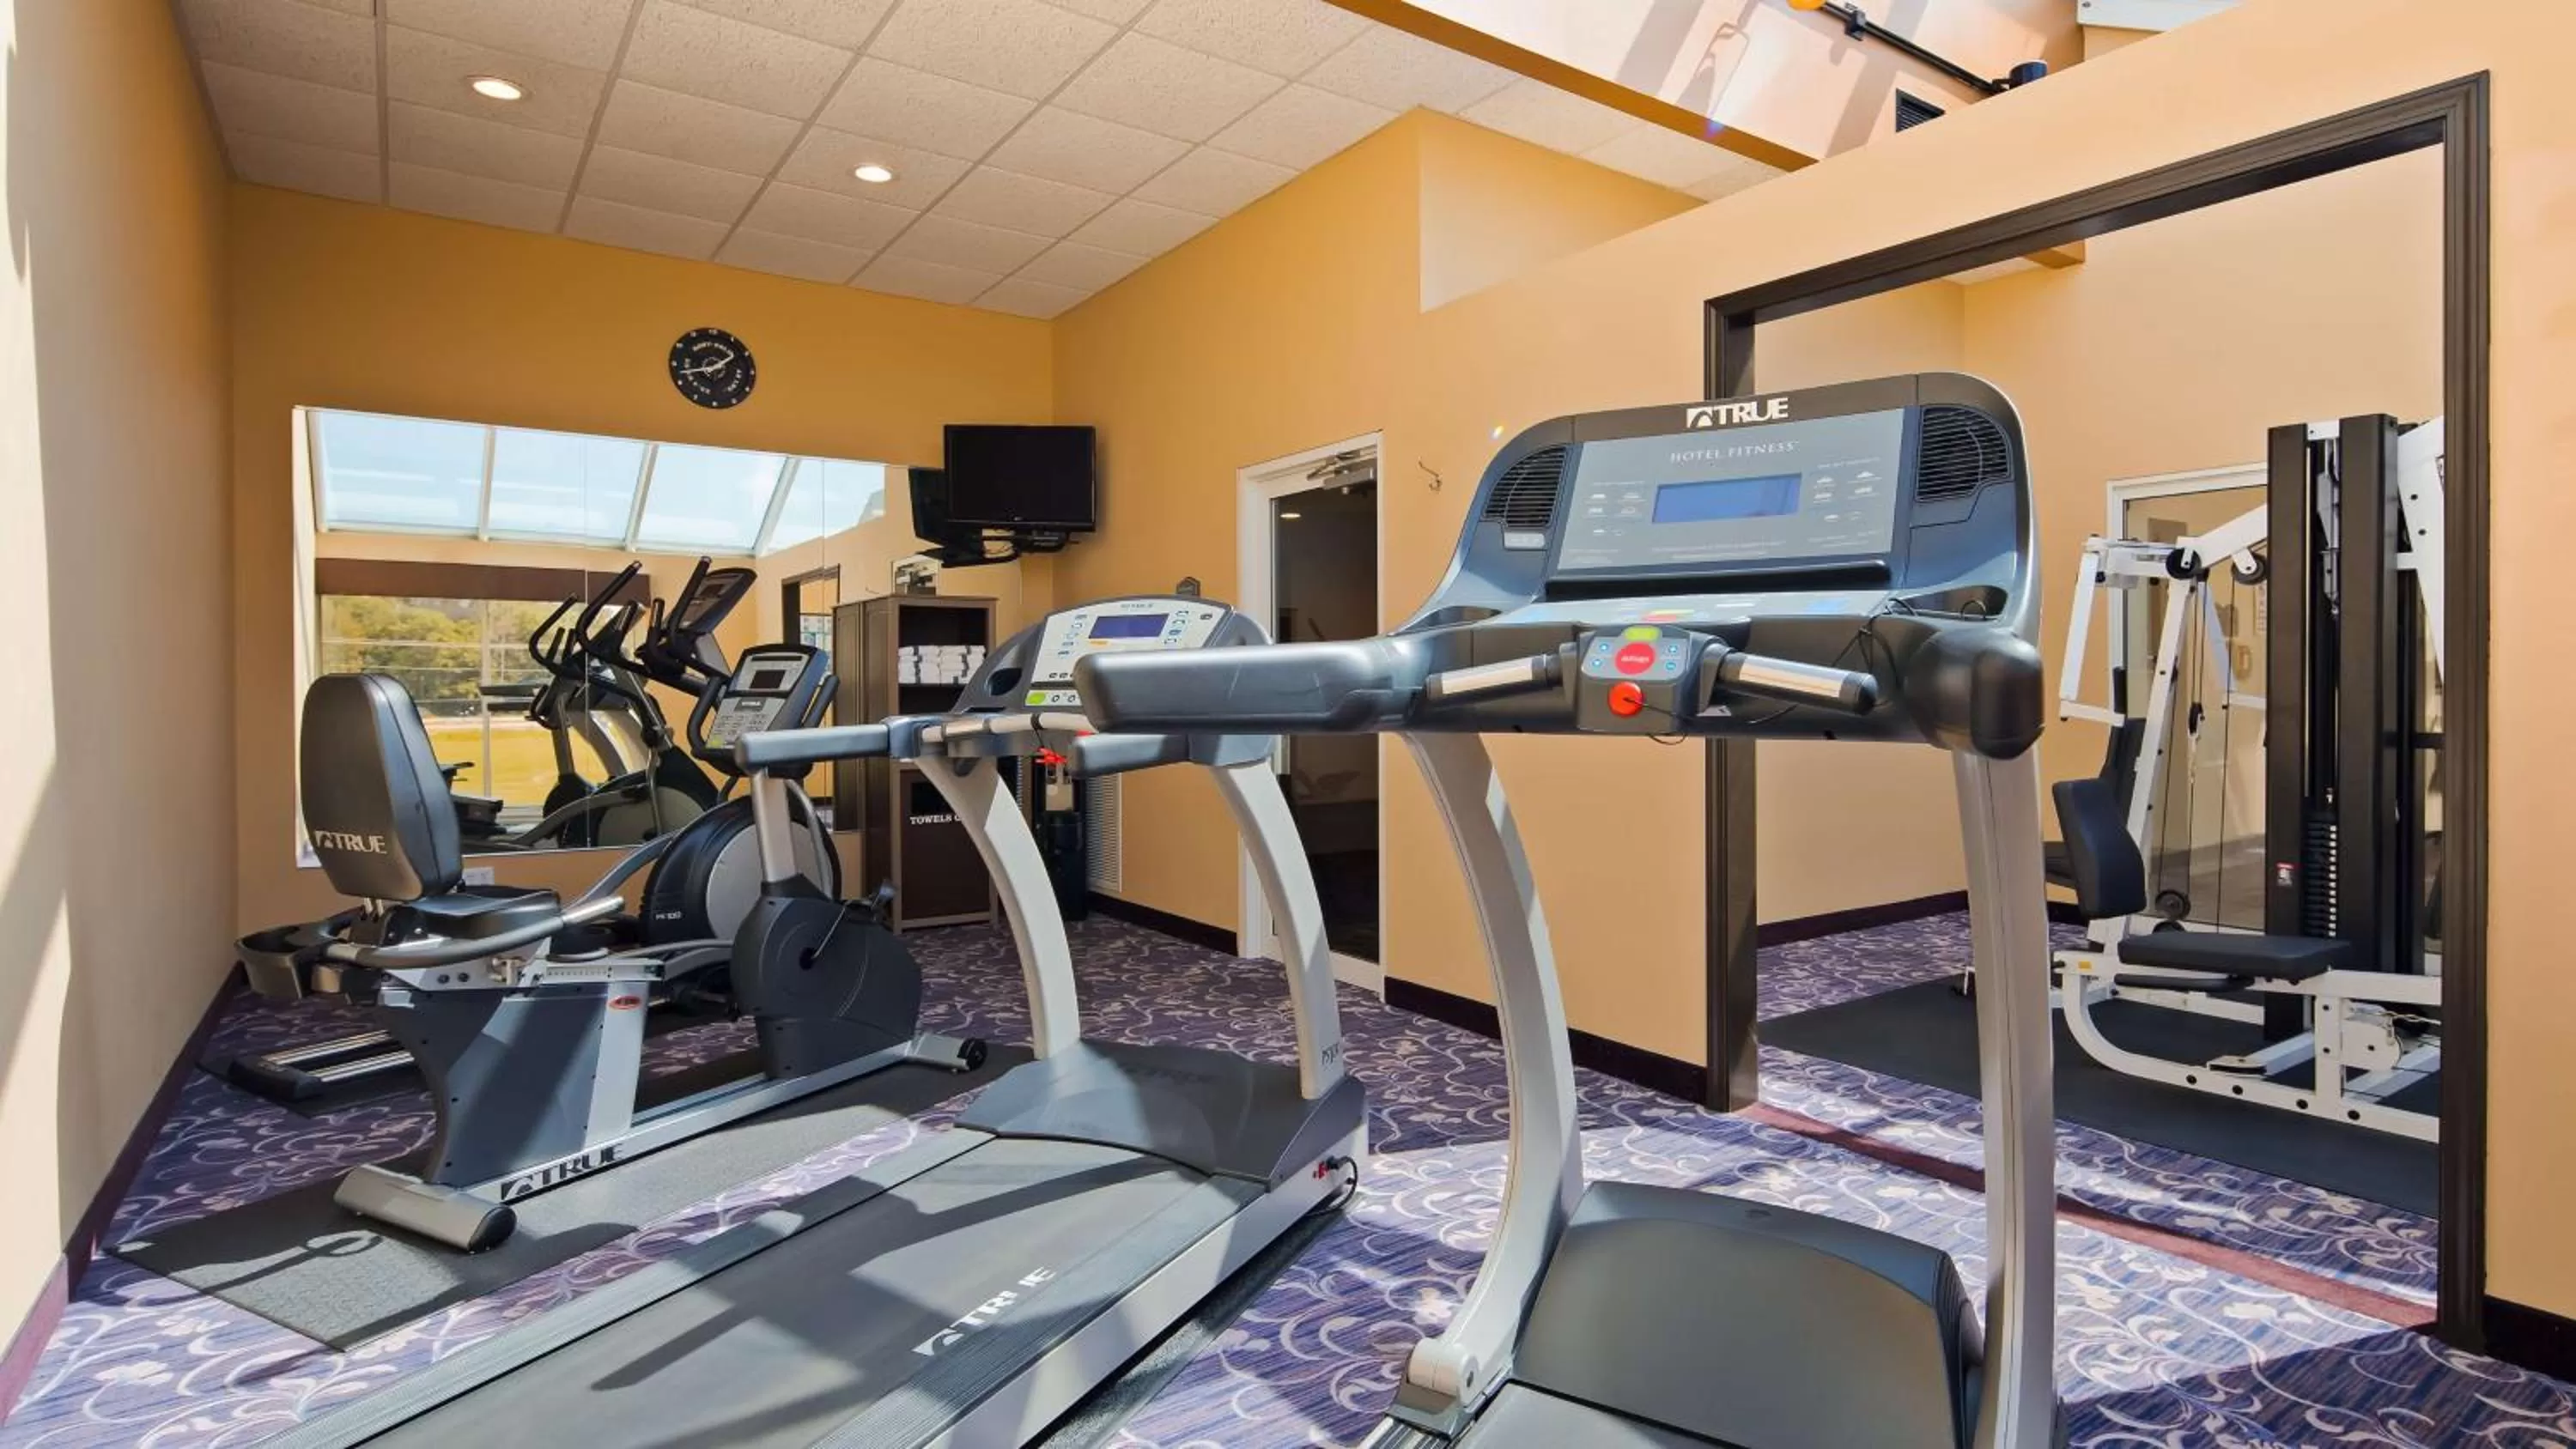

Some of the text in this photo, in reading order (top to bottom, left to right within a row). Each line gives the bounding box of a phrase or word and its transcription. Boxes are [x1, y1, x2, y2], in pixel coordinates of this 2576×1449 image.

[1713, 397, 1789, 425] TRUE
[1670, 441, 1794, 464] HOTEL FITNESS
[910, 814, 951, 825] TOWELS
[330, 831, 387, 854] TRUE
[533, 1143, 623, 1185] TRUE
[950, 1266, 1057, 1328] TRUE
